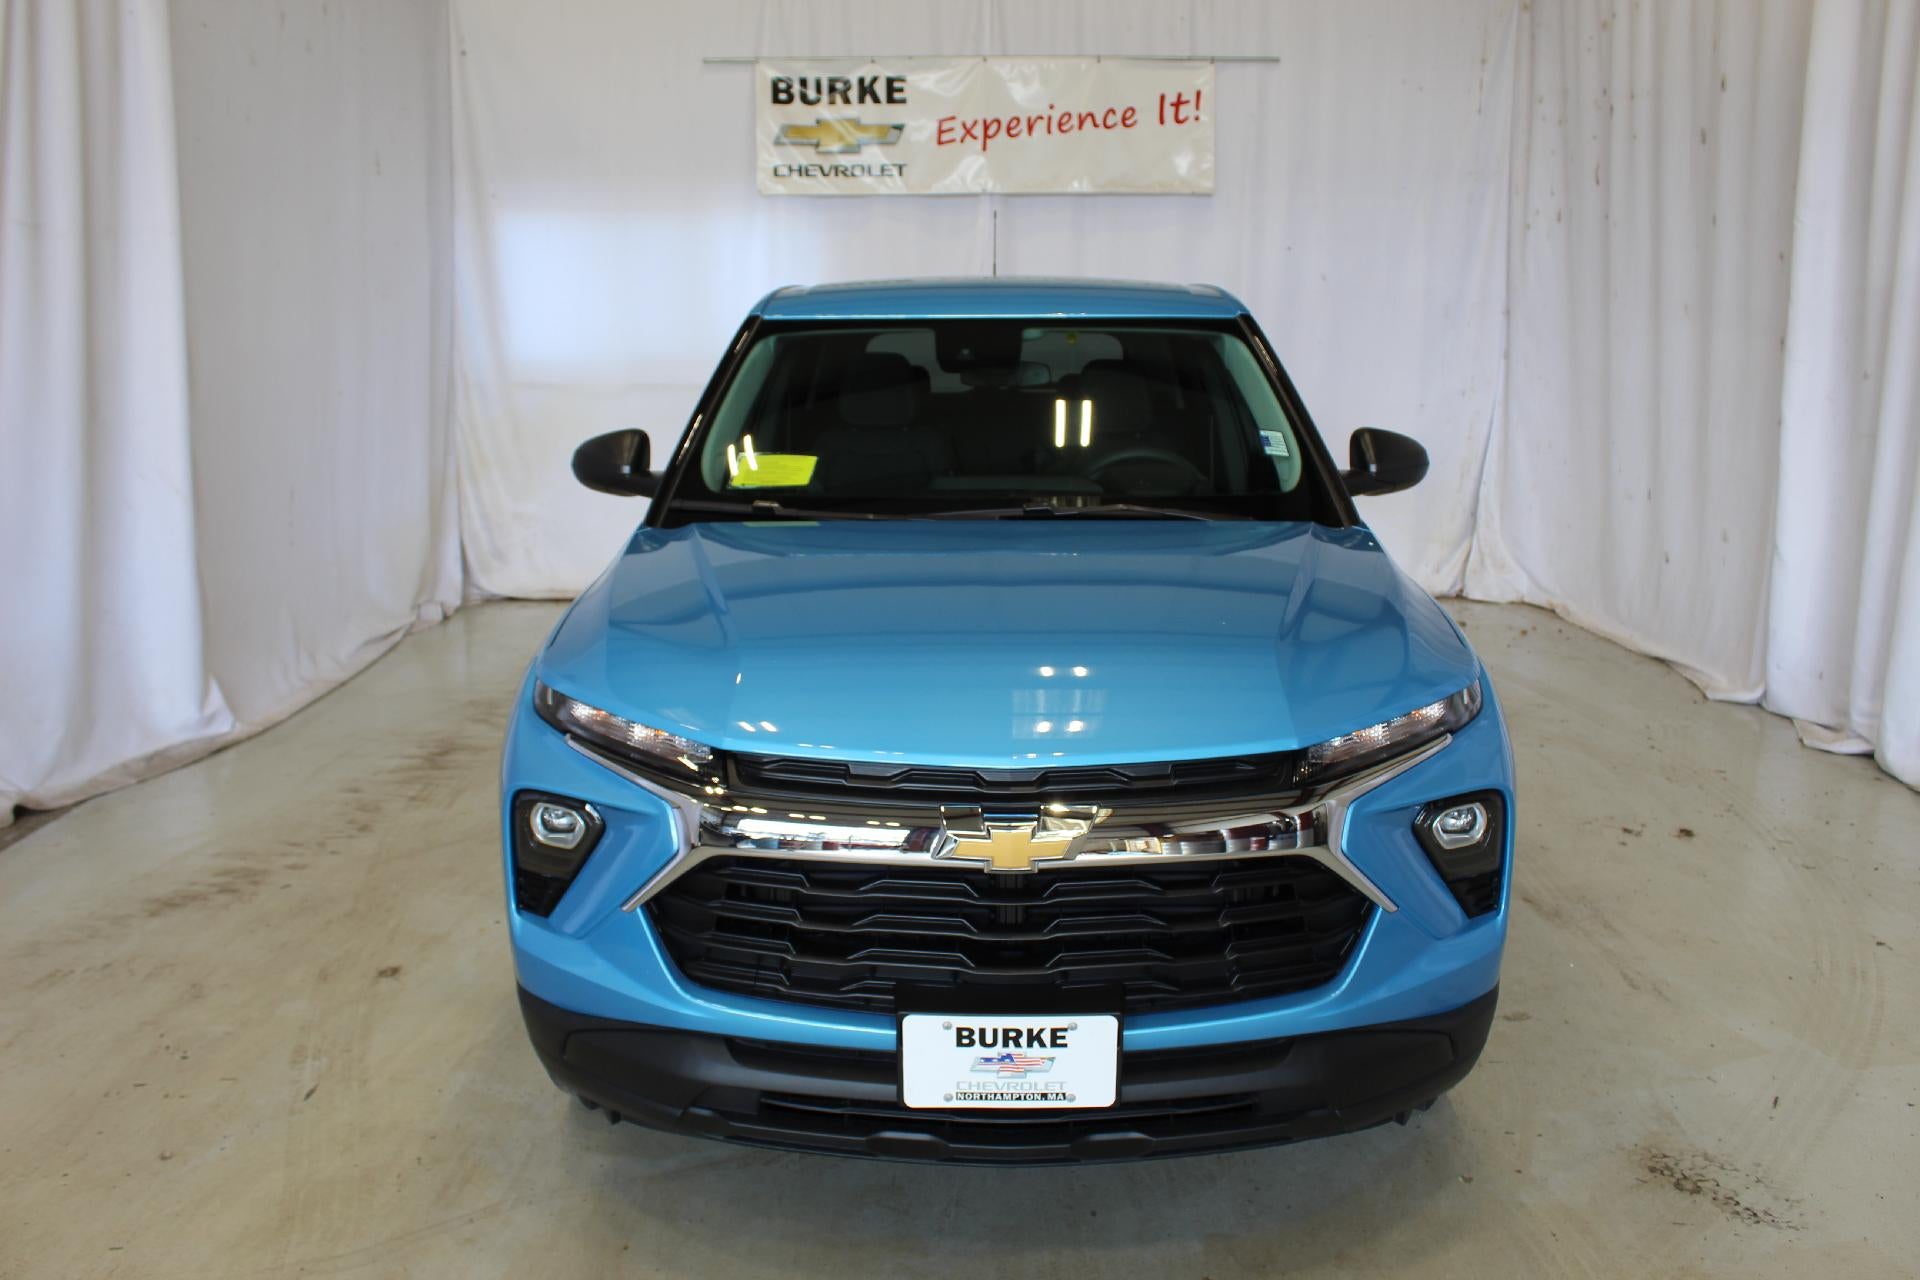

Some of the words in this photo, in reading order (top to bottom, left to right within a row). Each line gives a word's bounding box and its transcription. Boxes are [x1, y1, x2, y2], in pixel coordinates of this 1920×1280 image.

[771, 76, 907, 105] BURKE
[935, 103, 1138, 152] Experience
[1158, 89, 1202, 126] It!
[773, 163, 908, 178] CHEVROLET
[956, 1027, 1068, 1048] BURKE
[956, 1081, 1067, 1091] CHEVROLET
[957, 1092, 1046, 1101] NORTHAMPTON,
[1049, 1092, 1065, 1101] MA
